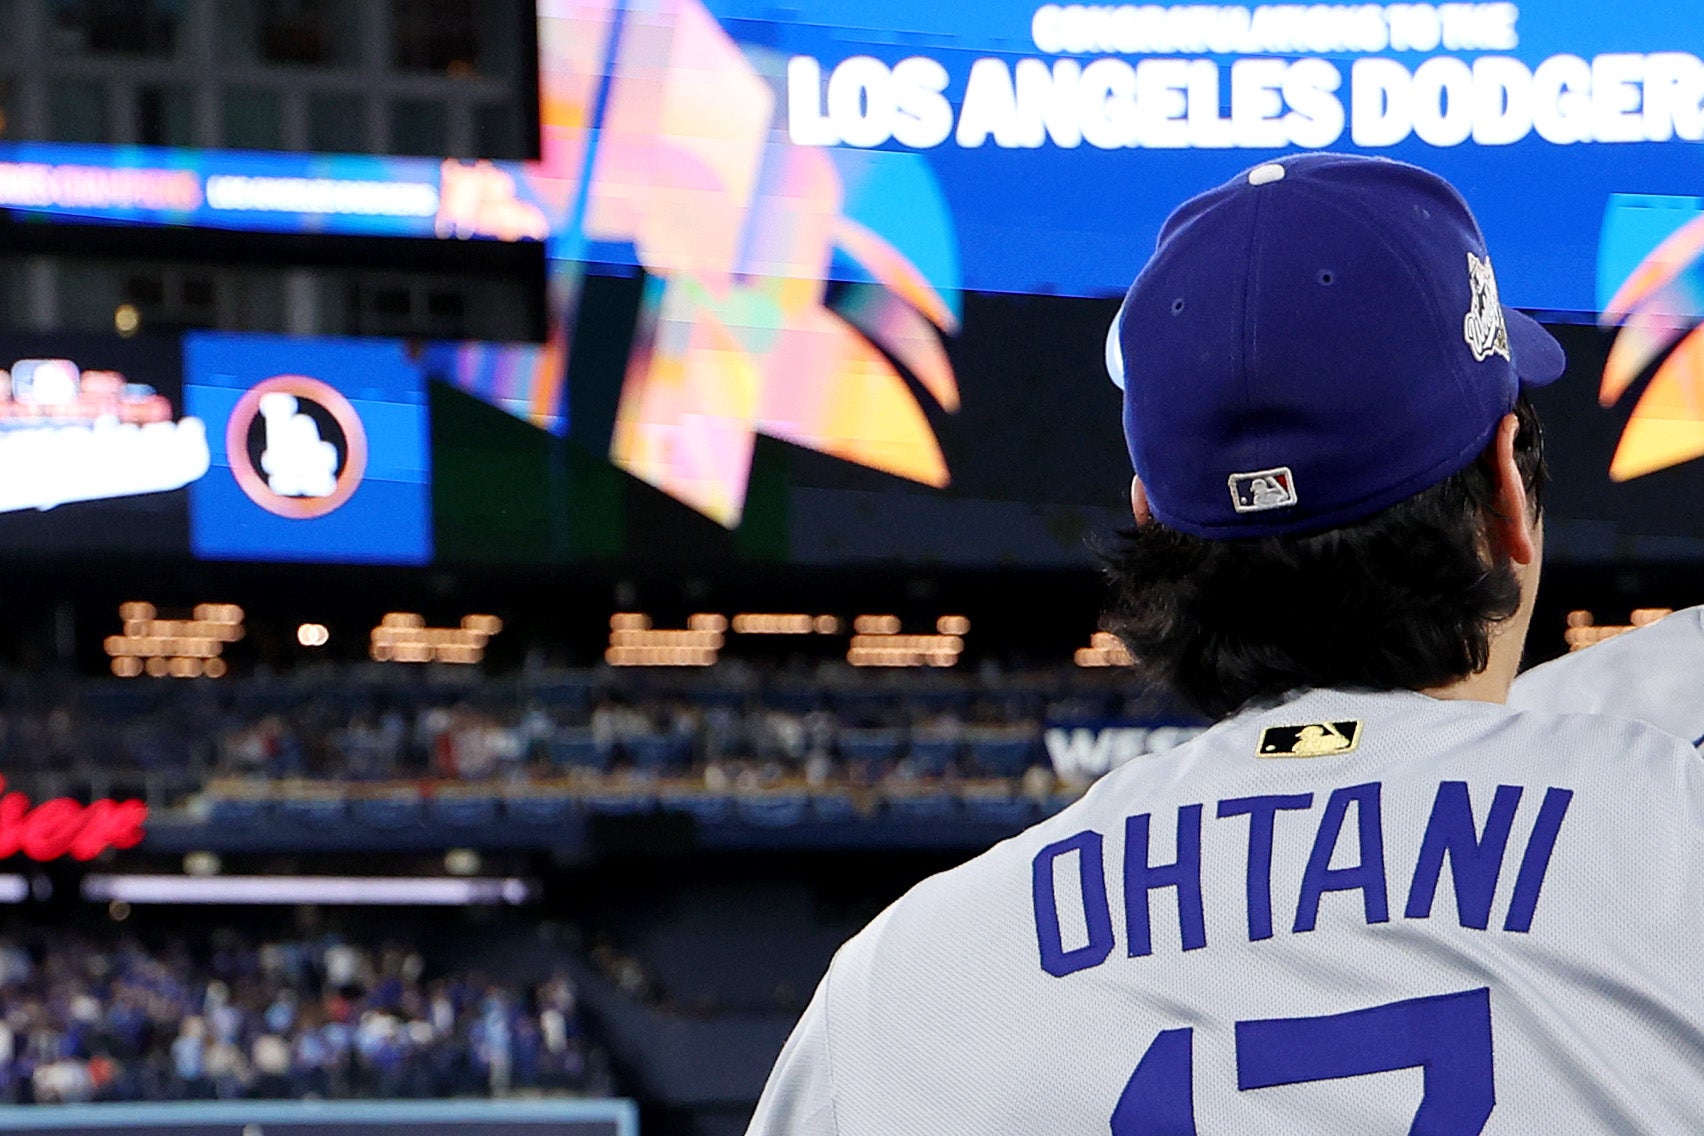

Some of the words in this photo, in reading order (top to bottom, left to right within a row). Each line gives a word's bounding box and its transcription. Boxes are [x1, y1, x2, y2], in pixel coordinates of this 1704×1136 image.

[788, 56, 954, 148] LOS
[955, 57, 1345, 149] ANGELES
[1031, 780, 1574, 978] OHTANI
